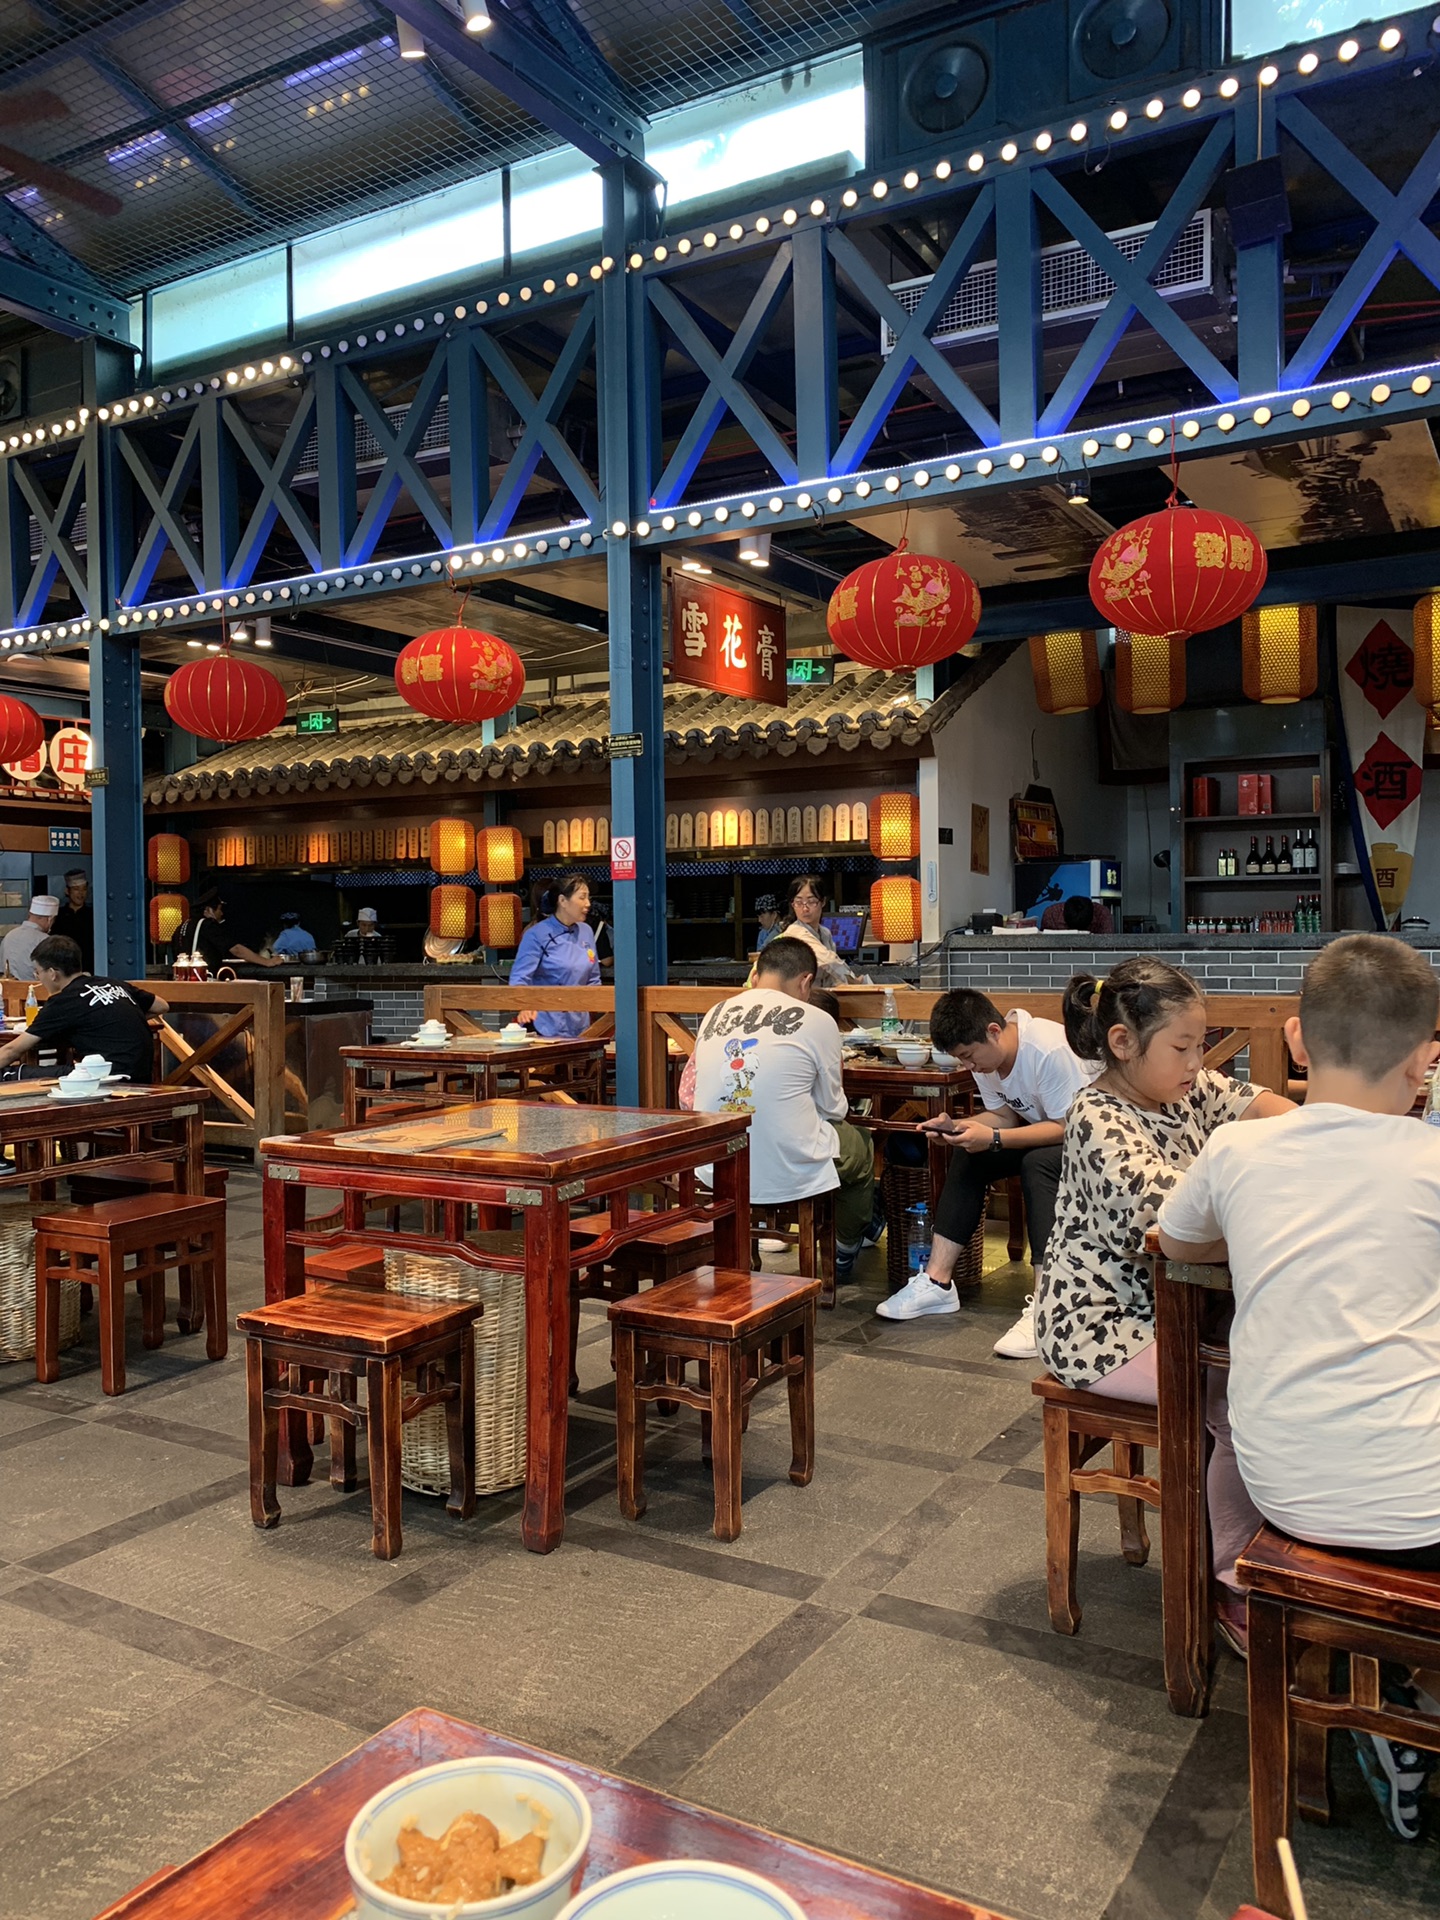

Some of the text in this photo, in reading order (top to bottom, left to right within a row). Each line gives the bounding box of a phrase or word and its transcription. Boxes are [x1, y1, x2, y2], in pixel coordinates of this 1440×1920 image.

[1193, 532, 1253, 571] 發財
[682, 601, 778, 681] 雪花膏
